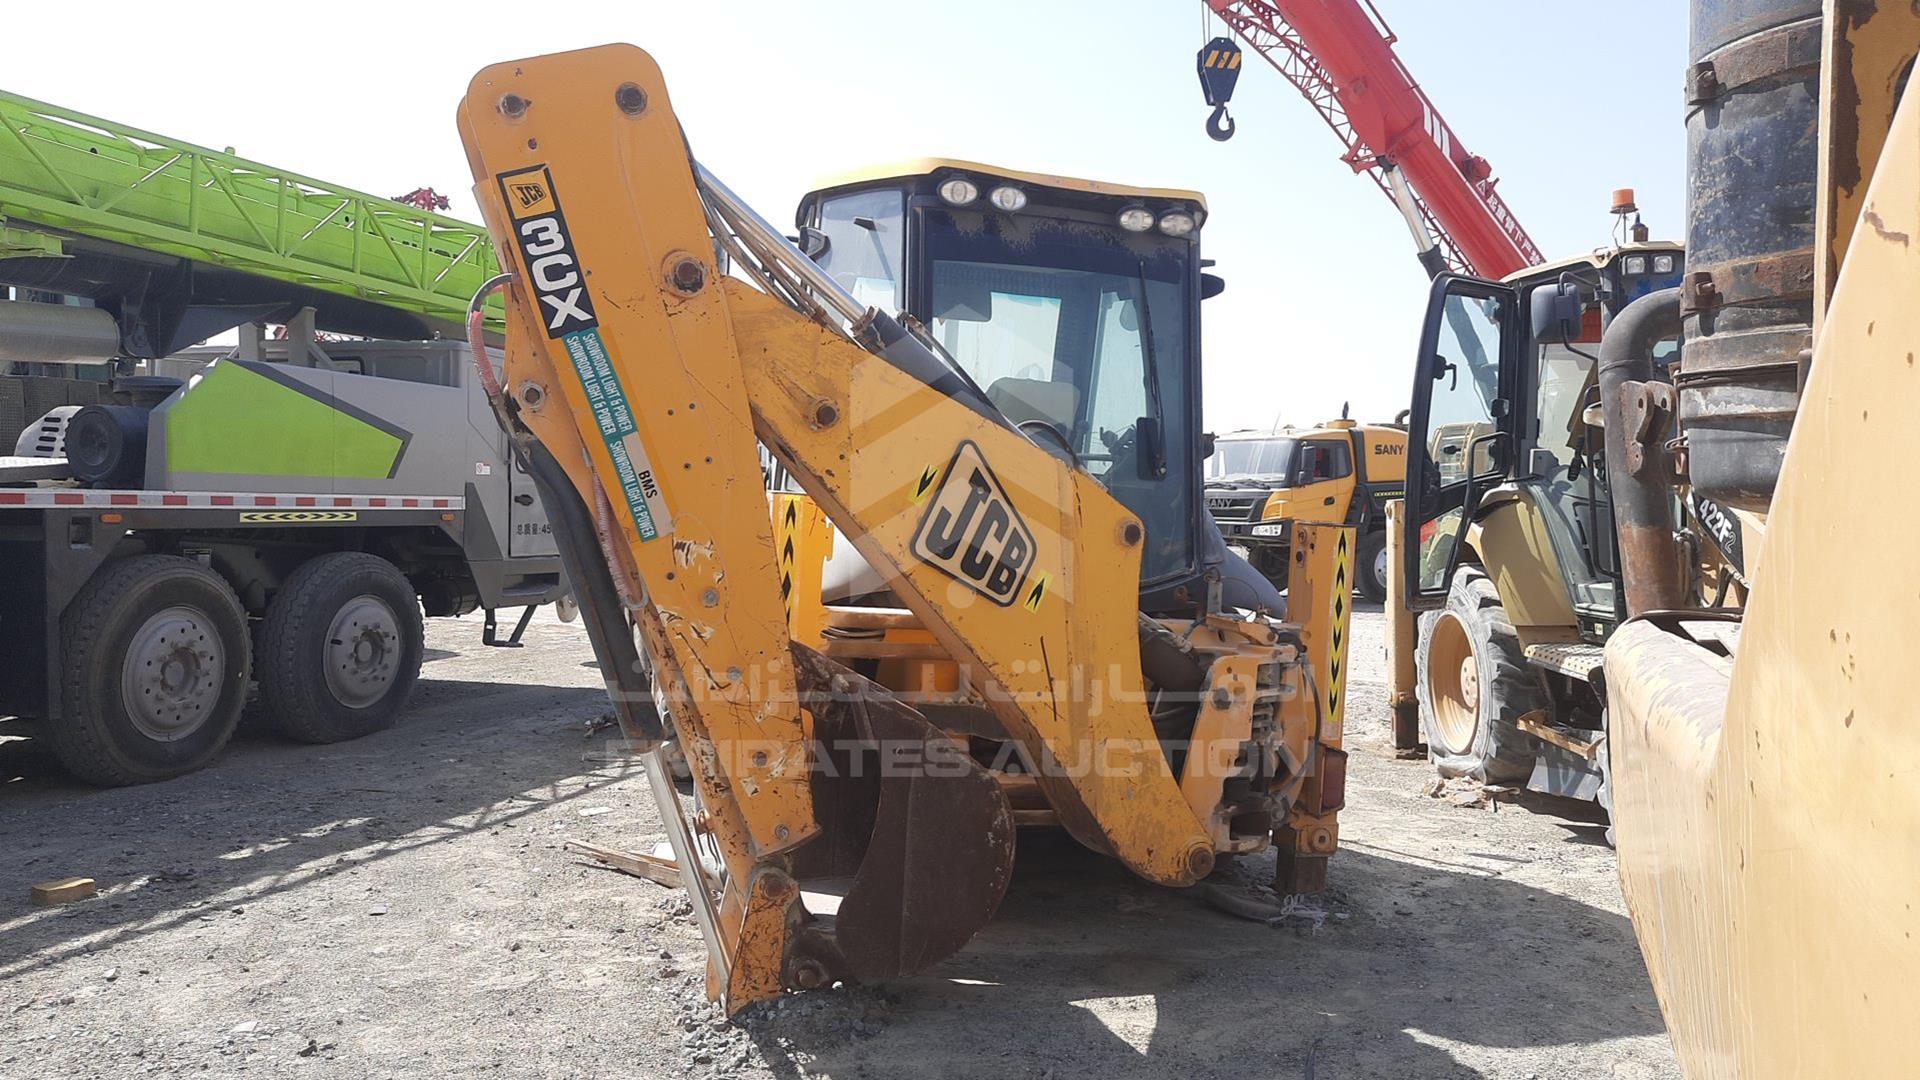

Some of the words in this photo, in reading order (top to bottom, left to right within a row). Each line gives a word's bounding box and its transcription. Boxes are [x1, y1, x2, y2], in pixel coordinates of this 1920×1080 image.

[514, 184, 545, 206] JCB
[521, 217, 593, 329] 3CX
[567, 336, 595, 380] SHOWROOM
[585, 379, 603, 401] LIGHT
[596, 408, 616, 435] POWER
[583, 333, 611, 377] SHOWROOM
[601, 375, 620, 398] LIGHT
[611, 405, 632, 432] POWER
[610, 441, 635, 482] SHOWROOM
[625, 482, 643, 505] LIGHT
[636, 511, 655, 537] POWER
[639, 470, 657, 498] BMS
[1375, 444, 1404, 455] SANY
[925, 466, 1027, 596] JCB
